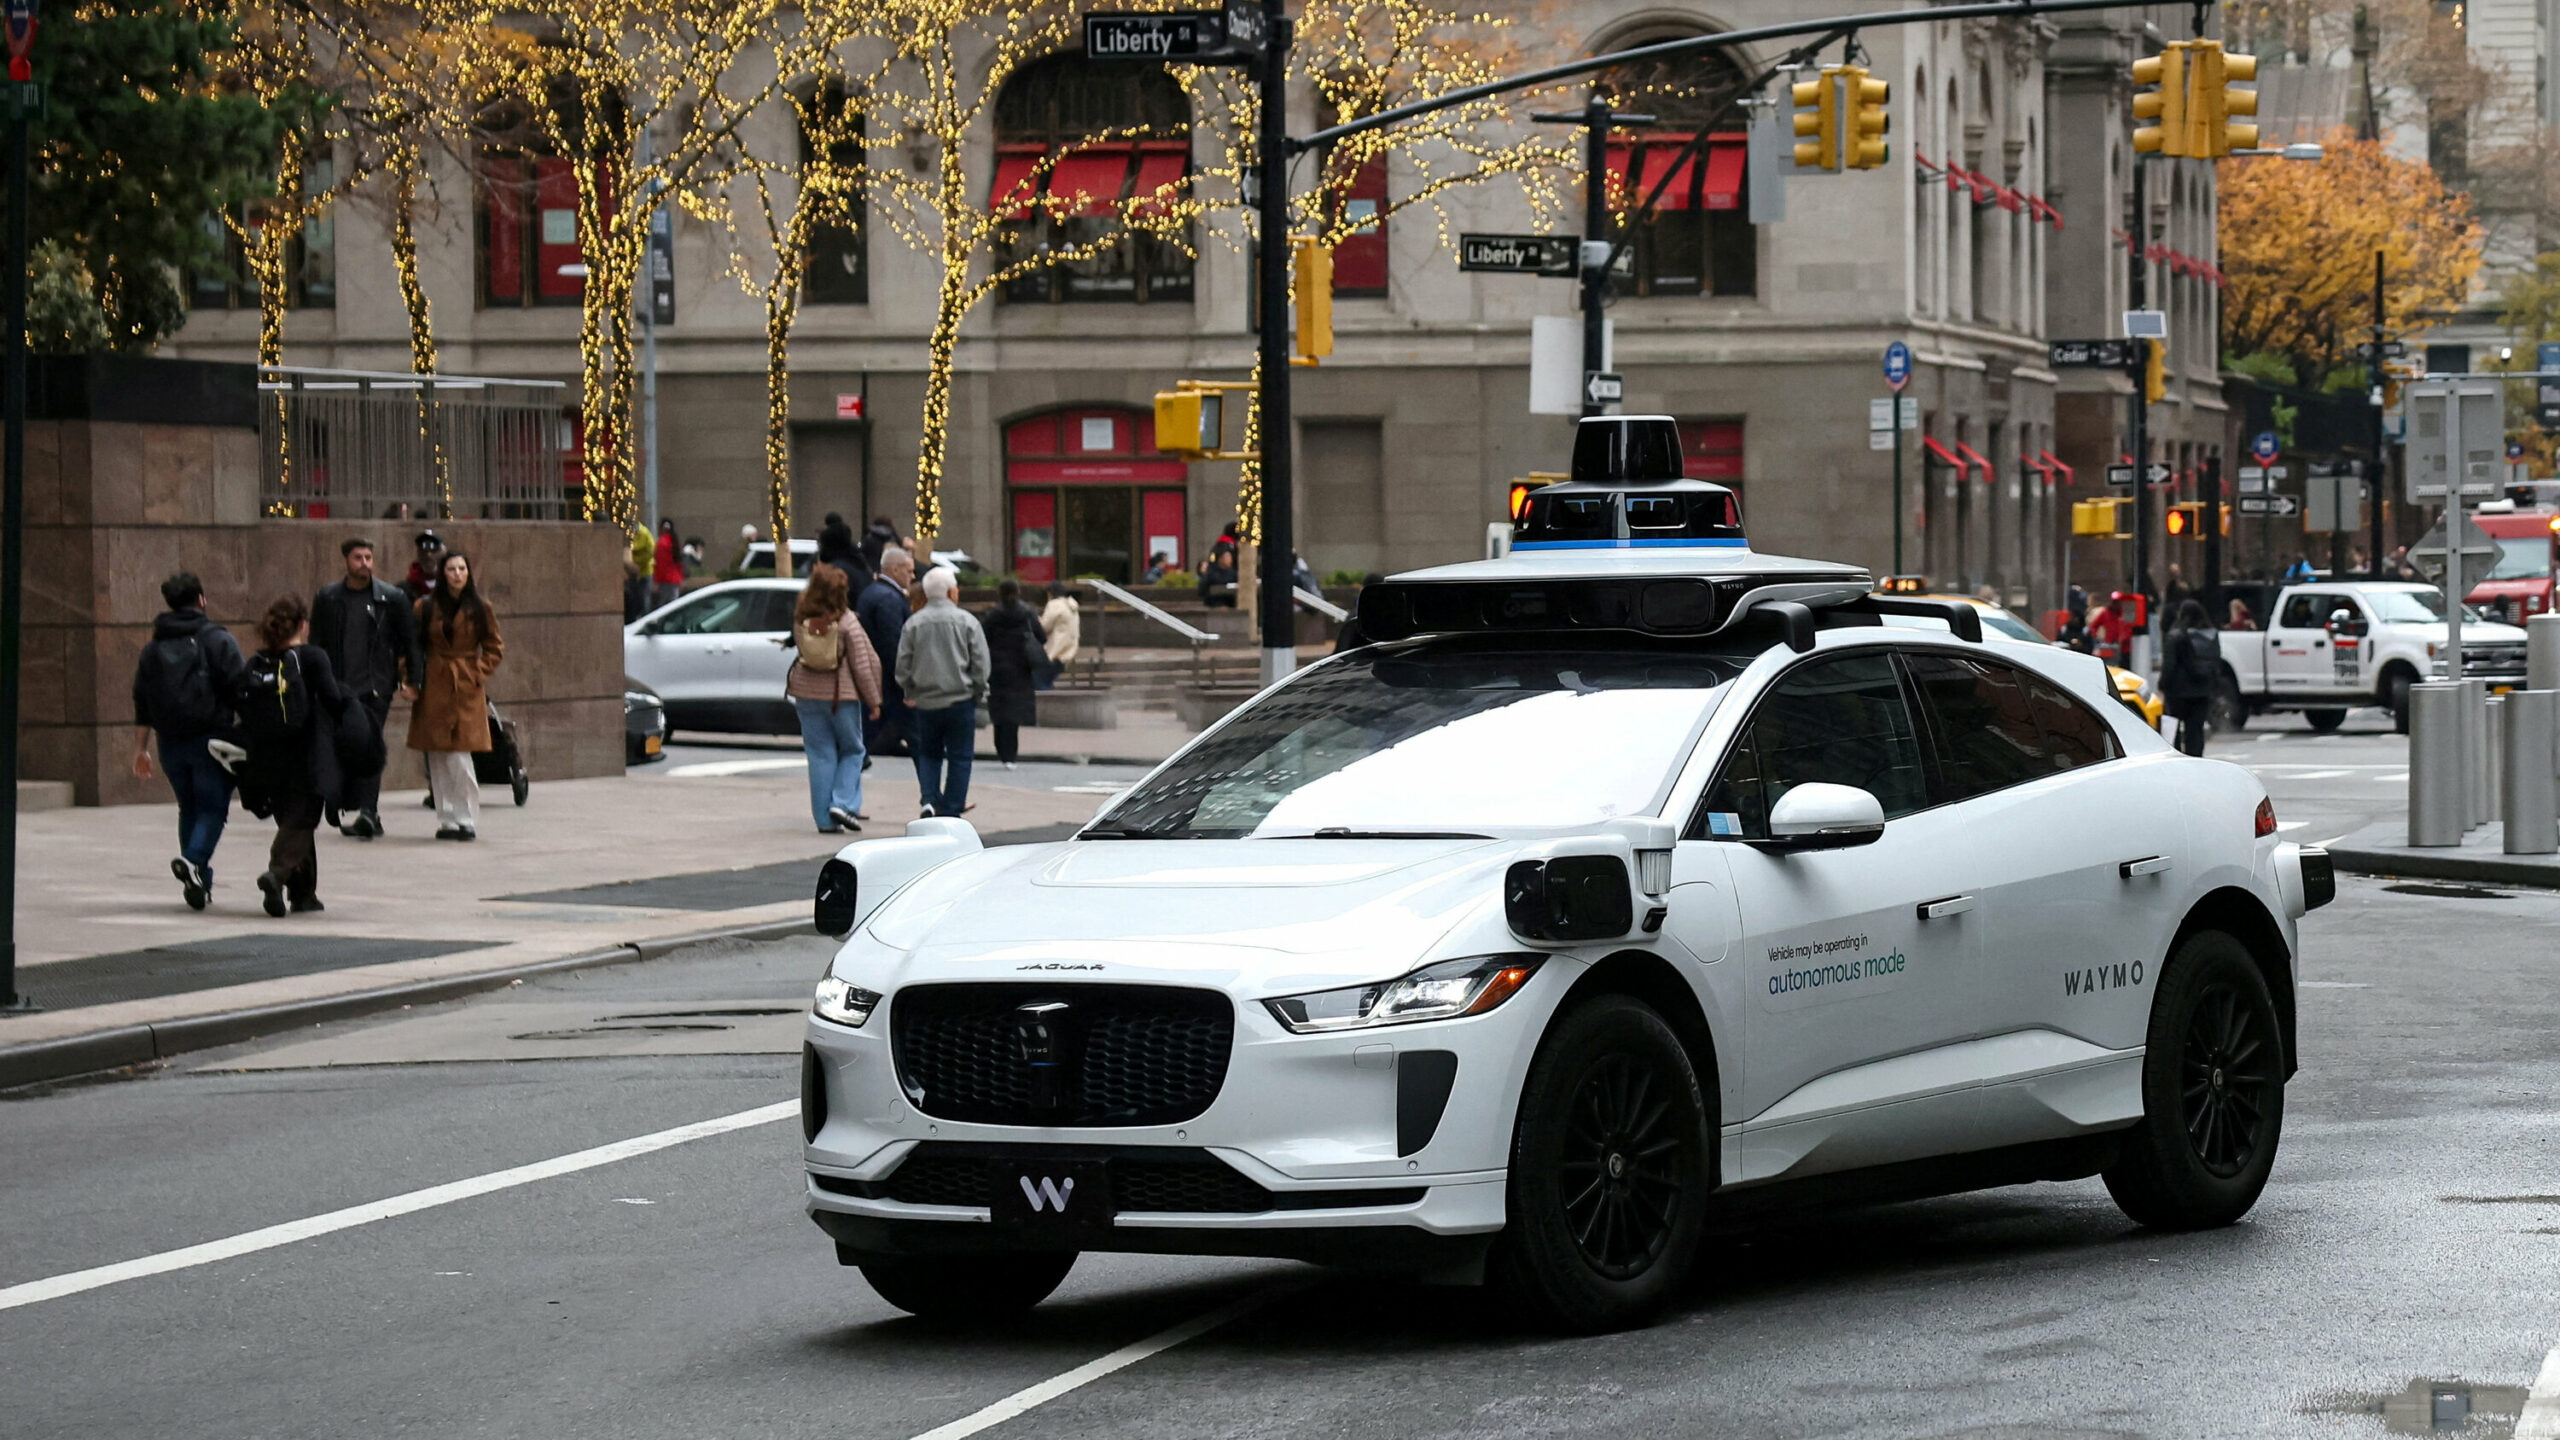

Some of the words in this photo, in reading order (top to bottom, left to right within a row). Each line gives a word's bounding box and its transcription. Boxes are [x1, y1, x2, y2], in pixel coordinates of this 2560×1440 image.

[1096, 28, 1173, 55] Liberty
[1468, 244, 1525, 267] Liberty
[2053, 347, 2089, 362] Cedar
[1768, 945, 1794, 961] Vehicle
[1795, 945, 1812, 959] may
[1813, 941, 1823, 954] be
[1824, 936, 1860, 956] operating
[1861, 933, 1868, 946] in
[1769, 959, 1861, 995] autonomous
[1865, 946, 1905, 977] mode
[2065, 960, 2143, 996] WAYMO
